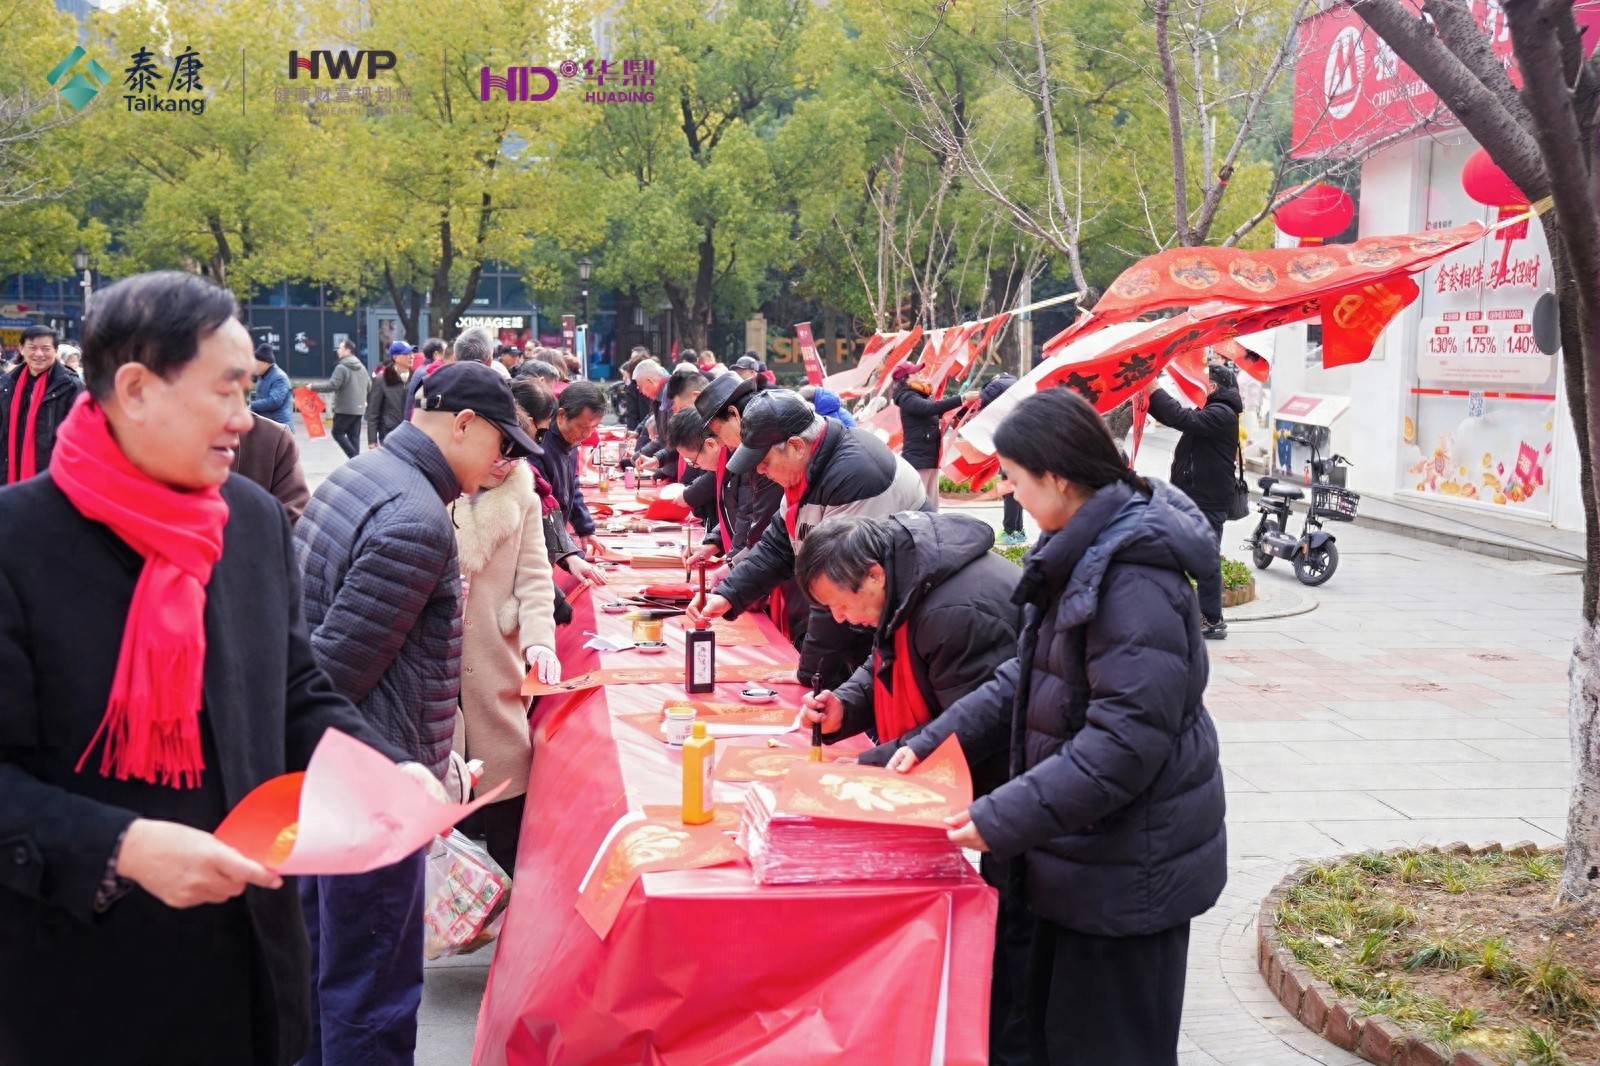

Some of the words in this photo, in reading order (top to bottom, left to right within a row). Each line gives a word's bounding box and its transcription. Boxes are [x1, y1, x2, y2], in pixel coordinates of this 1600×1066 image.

[1429, 337, 1457, 353] 1.30%
[1466, 337, 1496, 353] 1.75%
[1507, 336, 1540, 353] 1.40%
